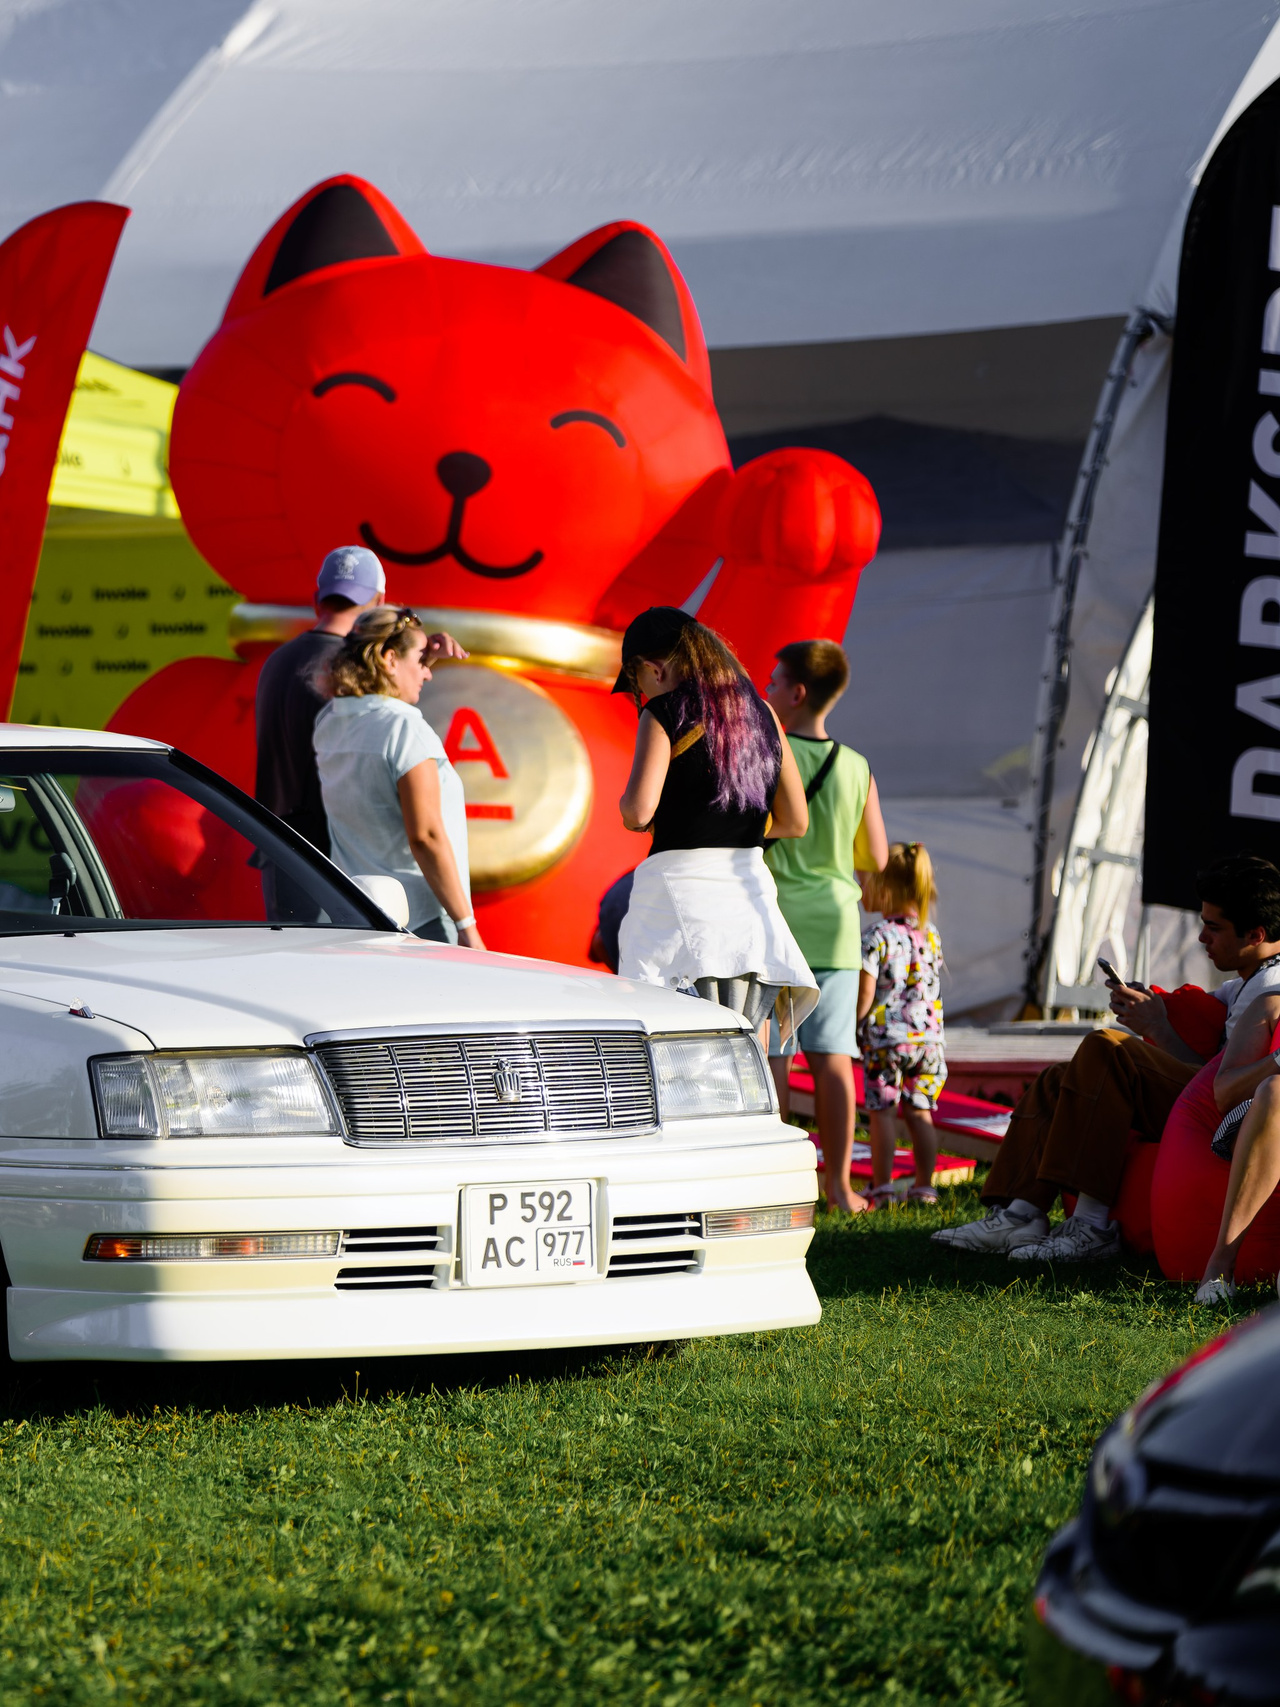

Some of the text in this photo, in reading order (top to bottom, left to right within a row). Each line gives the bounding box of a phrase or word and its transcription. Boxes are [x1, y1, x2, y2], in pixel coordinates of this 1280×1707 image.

[520, 1190, 573, 1223] 592
[543, 1231, 585, 1257] 977
[553, 1258, 572, 1267] RUS
